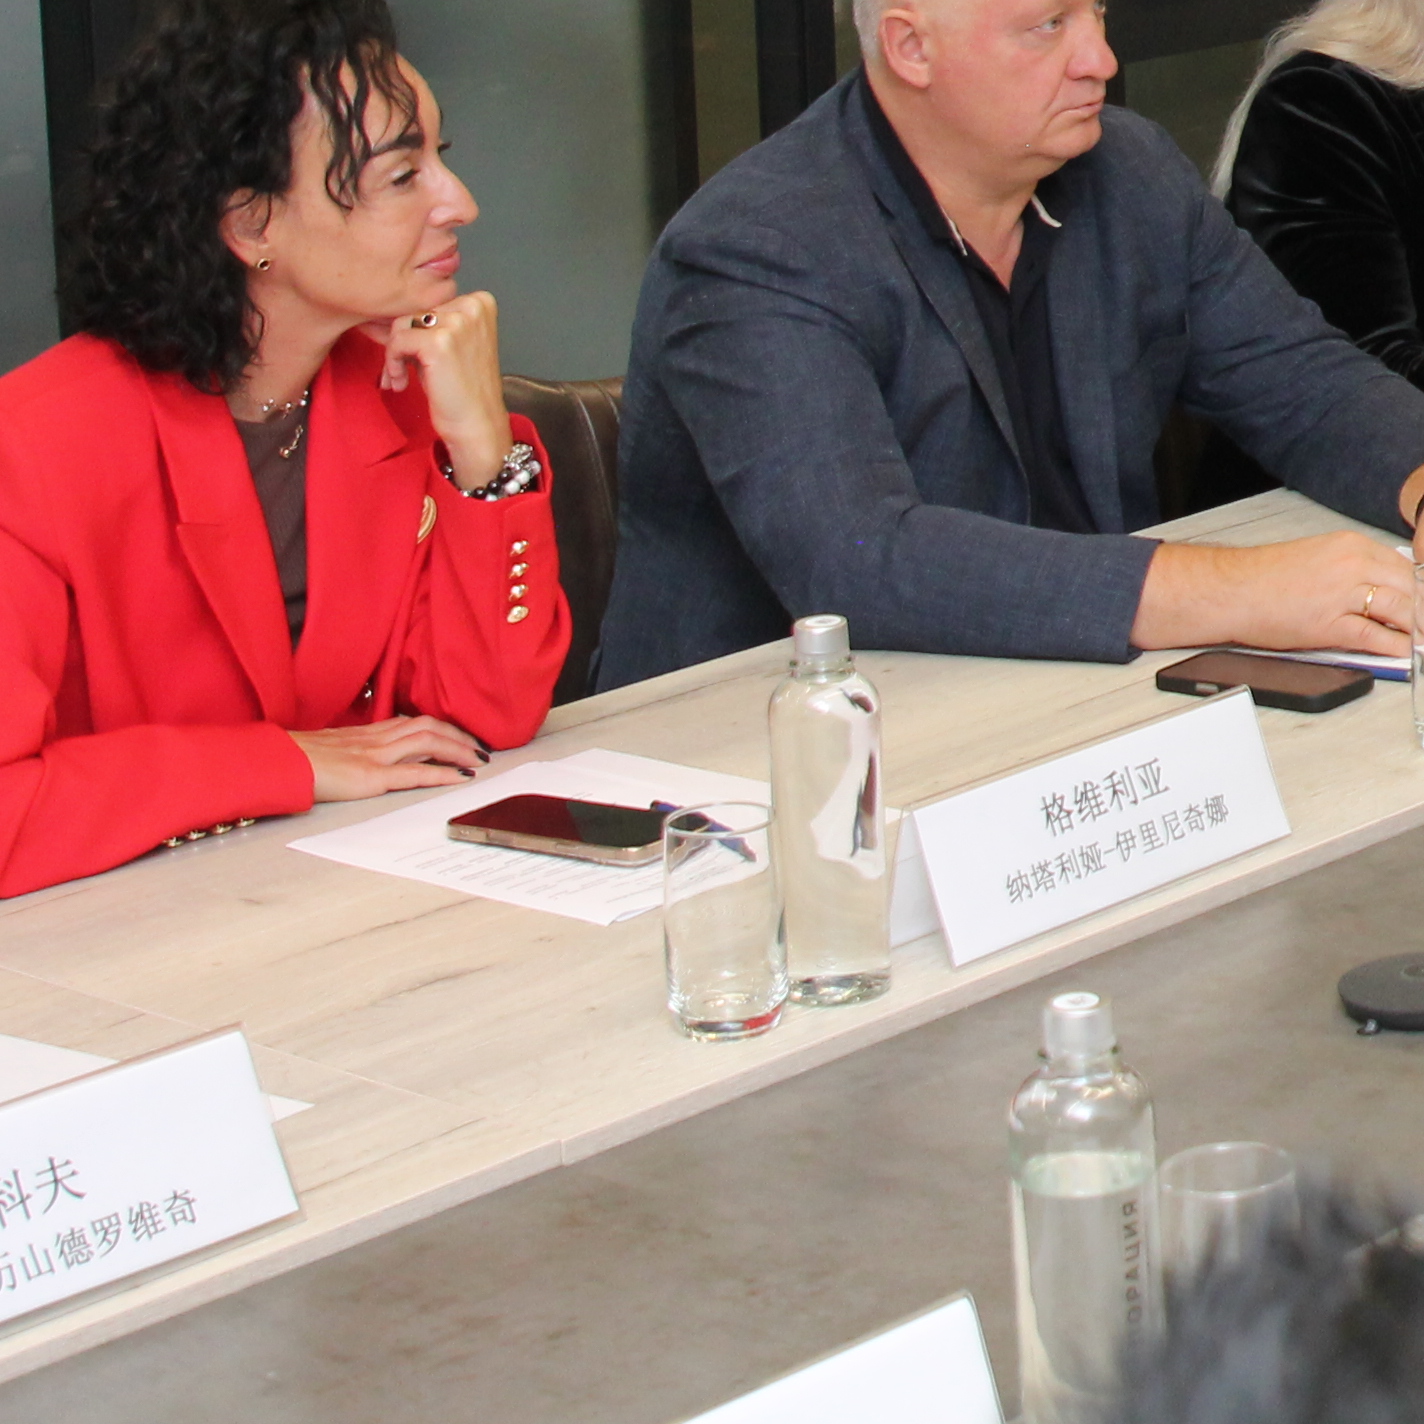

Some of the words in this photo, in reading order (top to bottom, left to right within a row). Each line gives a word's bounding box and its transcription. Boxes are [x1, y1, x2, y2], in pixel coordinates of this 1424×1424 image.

[1040, 757, 1170, 837] 格维利亚
[1005, 793, 1230, 904] 纳塔利娅-伊里尼奇娜
